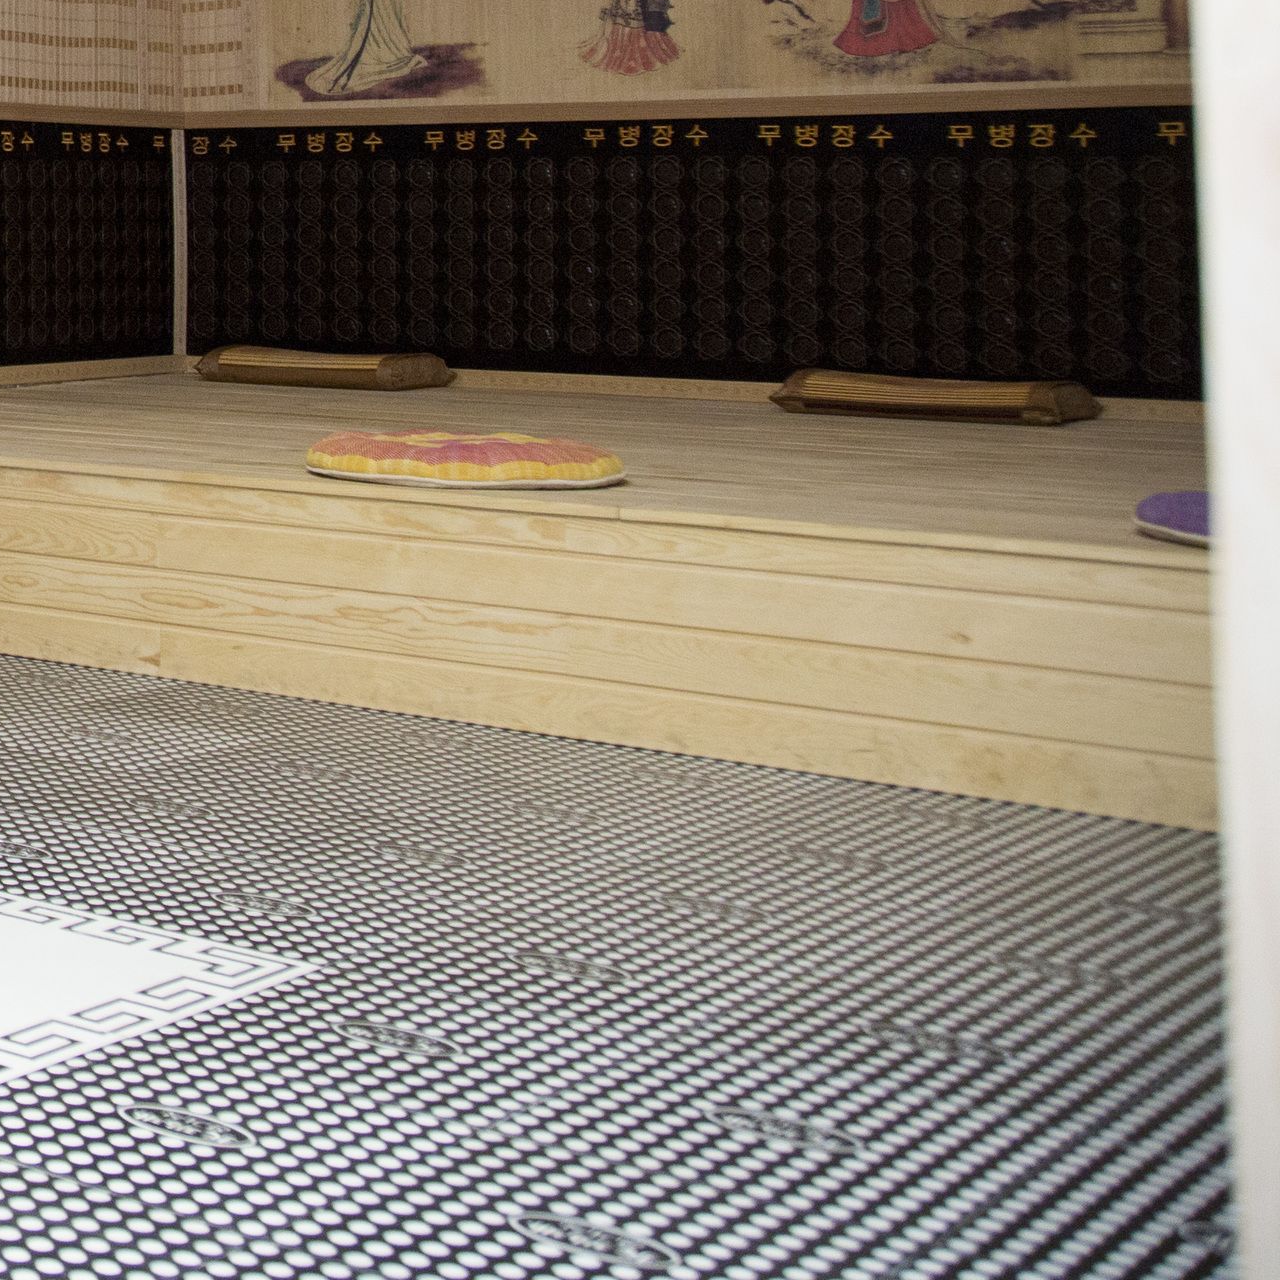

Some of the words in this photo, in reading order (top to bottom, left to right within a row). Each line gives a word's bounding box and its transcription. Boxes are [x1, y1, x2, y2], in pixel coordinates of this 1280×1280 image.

[60, 131, 129, 152] 무병장수
[276, 132, 384, 153] 무병장수
[424, 128, 540, 150] 무병장수
[582, 124, 708, 149] 무병장수
[757, 125, 894, 148] 무병장수
[947, 123, 1097, 148] 무병장수
